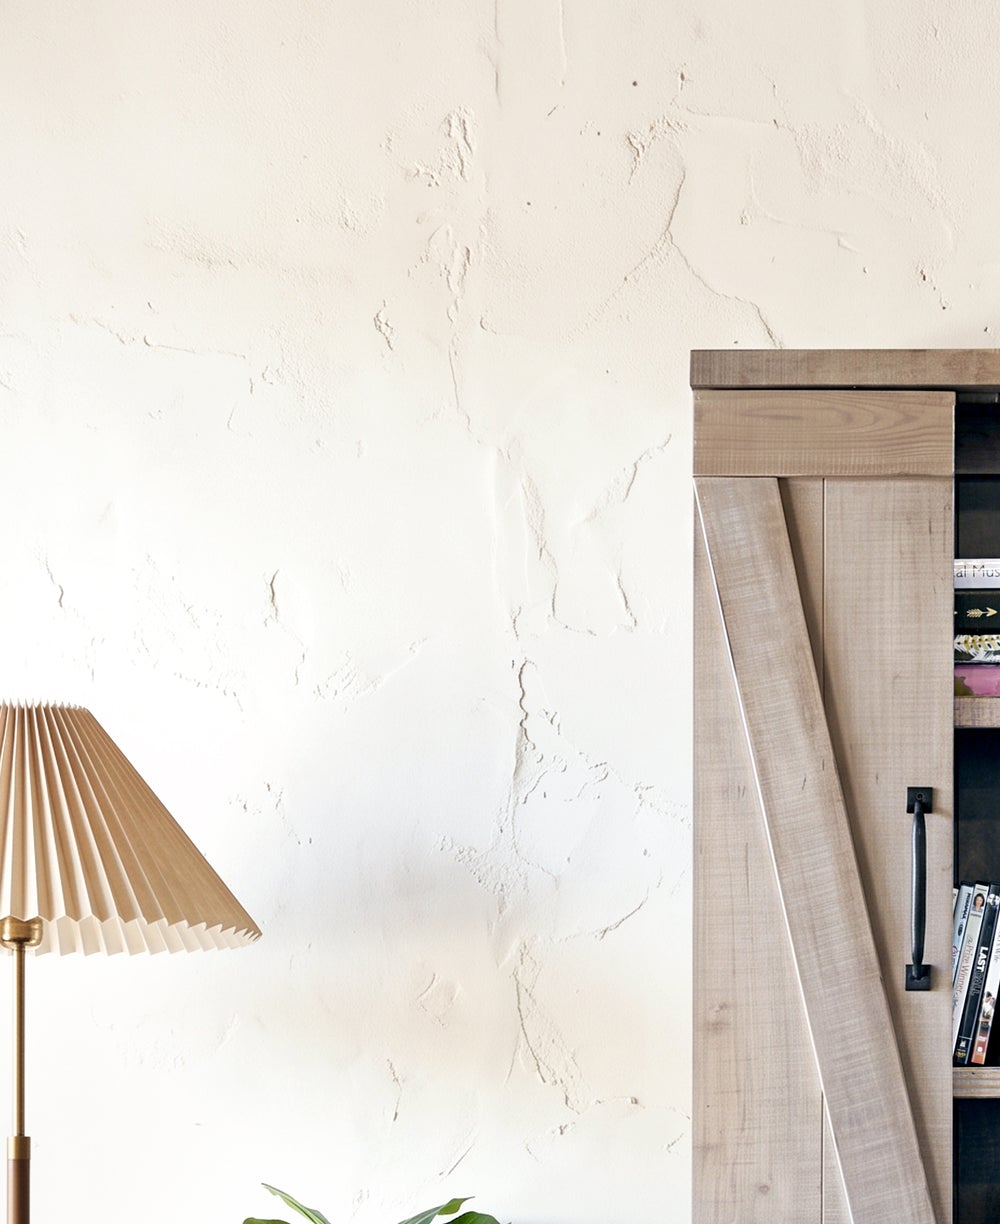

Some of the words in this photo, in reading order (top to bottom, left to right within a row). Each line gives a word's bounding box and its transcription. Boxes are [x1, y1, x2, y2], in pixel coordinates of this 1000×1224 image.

[953, 565, 967, 578] al
[962, 945, 974, 965] Prize
[976, 946, 989, 972] LAST
[956, 964, 969, 993] Winner
